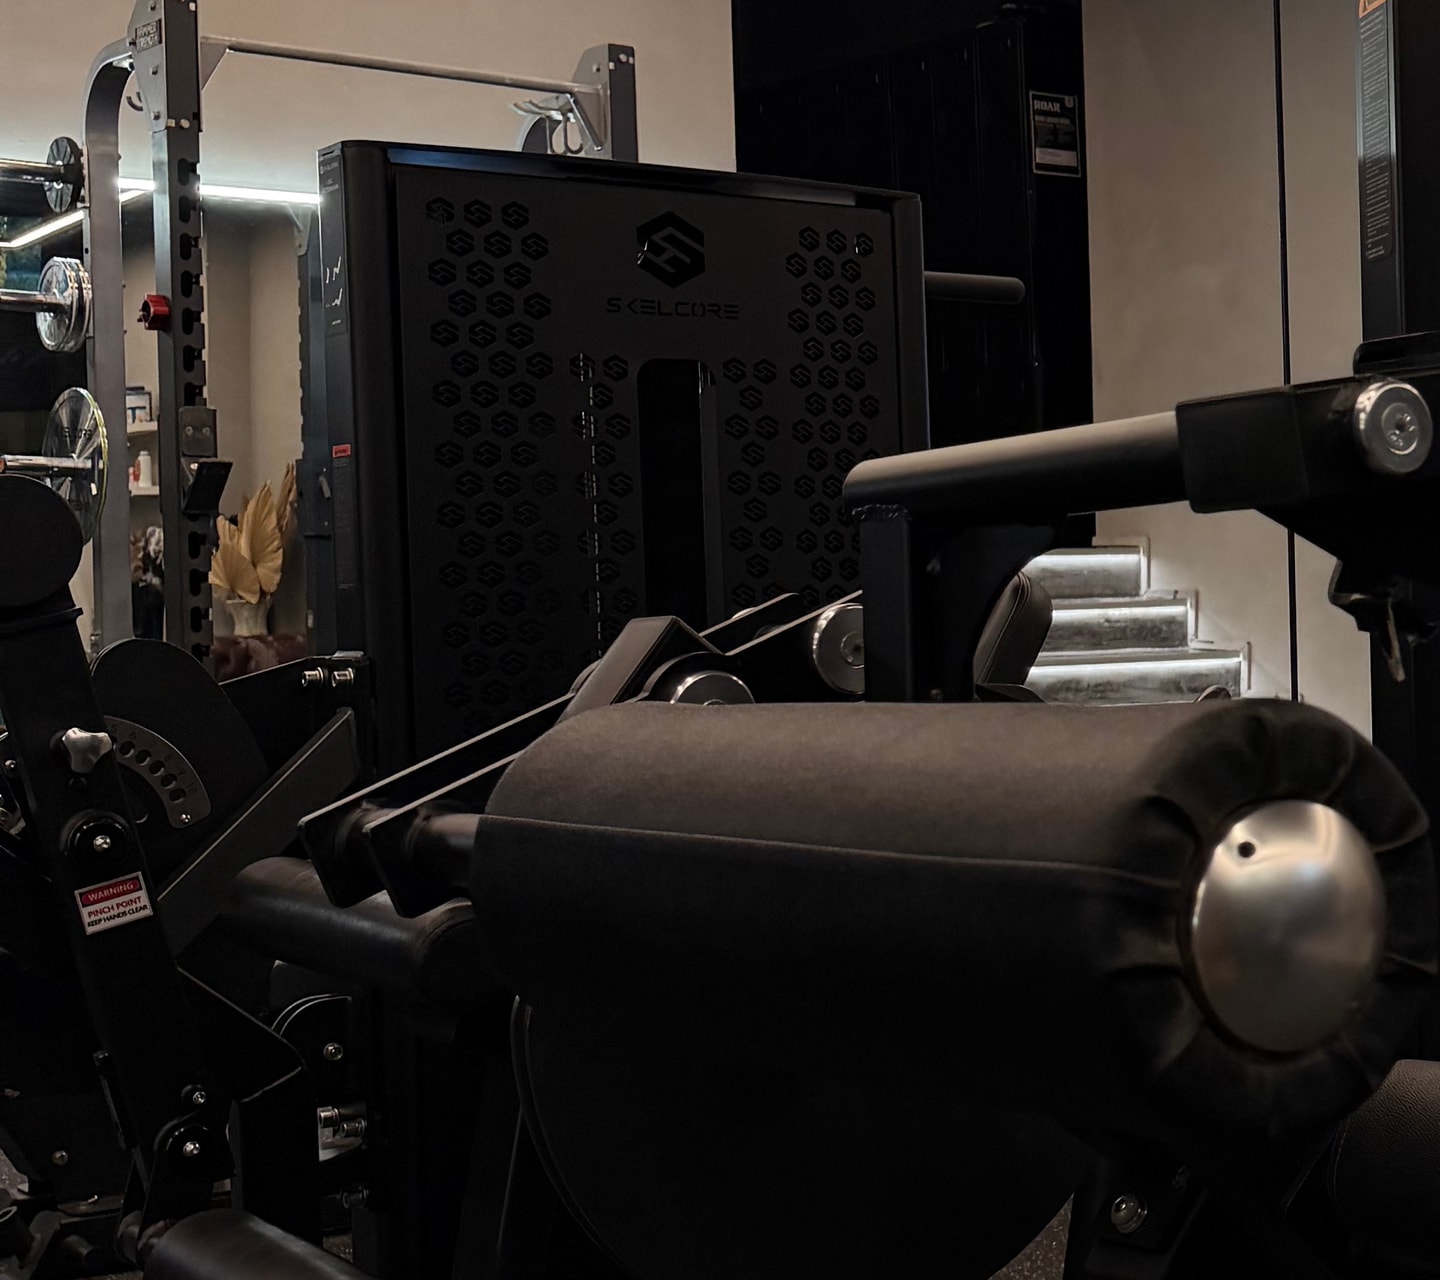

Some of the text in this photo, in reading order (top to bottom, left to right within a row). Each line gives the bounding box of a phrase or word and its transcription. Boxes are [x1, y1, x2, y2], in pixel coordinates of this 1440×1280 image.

[607, 297, 740, 320] SKELCORE
[88, 882, 135, 901] WARNING
[87, 896, 141, 919] PINCH POINT
[87, 904, 149, 928] KEEP HANDS CLEAR
